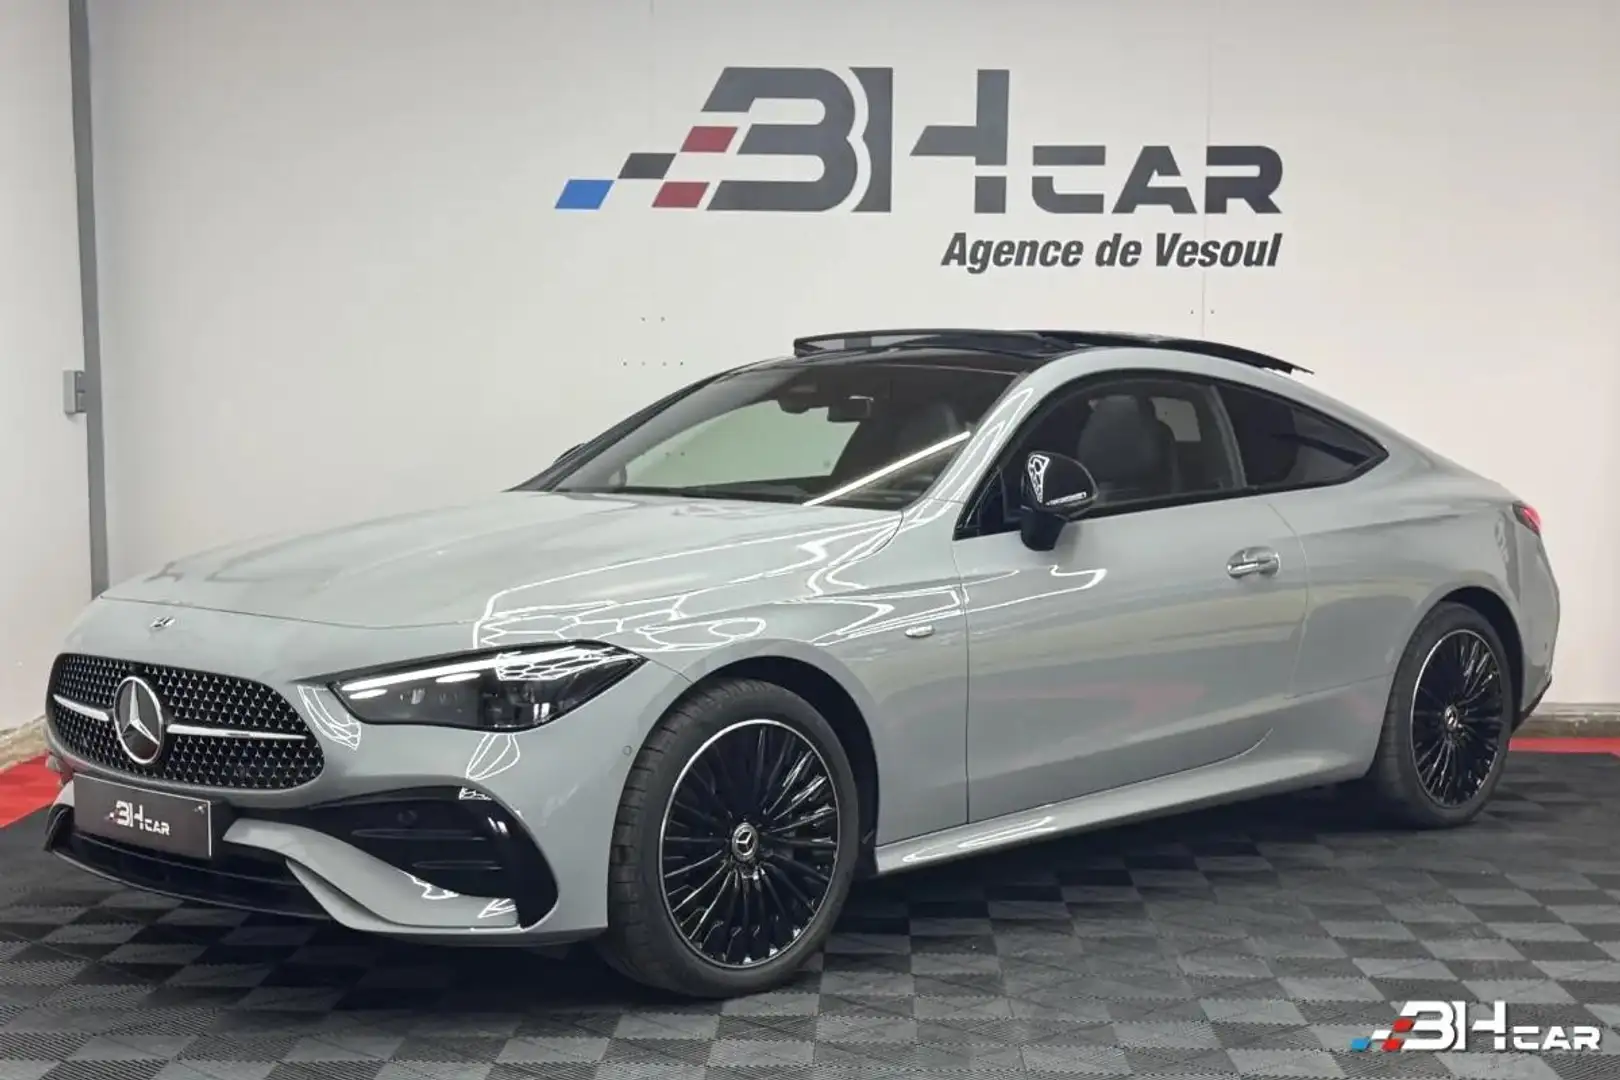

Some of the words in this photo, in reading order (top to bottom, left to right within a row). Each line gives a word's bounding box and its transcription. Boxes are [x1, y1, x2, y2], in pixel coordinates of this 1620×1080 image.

[941, 232, 1083, 274] Agence
[1096, 232, 1141, 267] de
[1154, 232, 1283, 268] Vesoul
